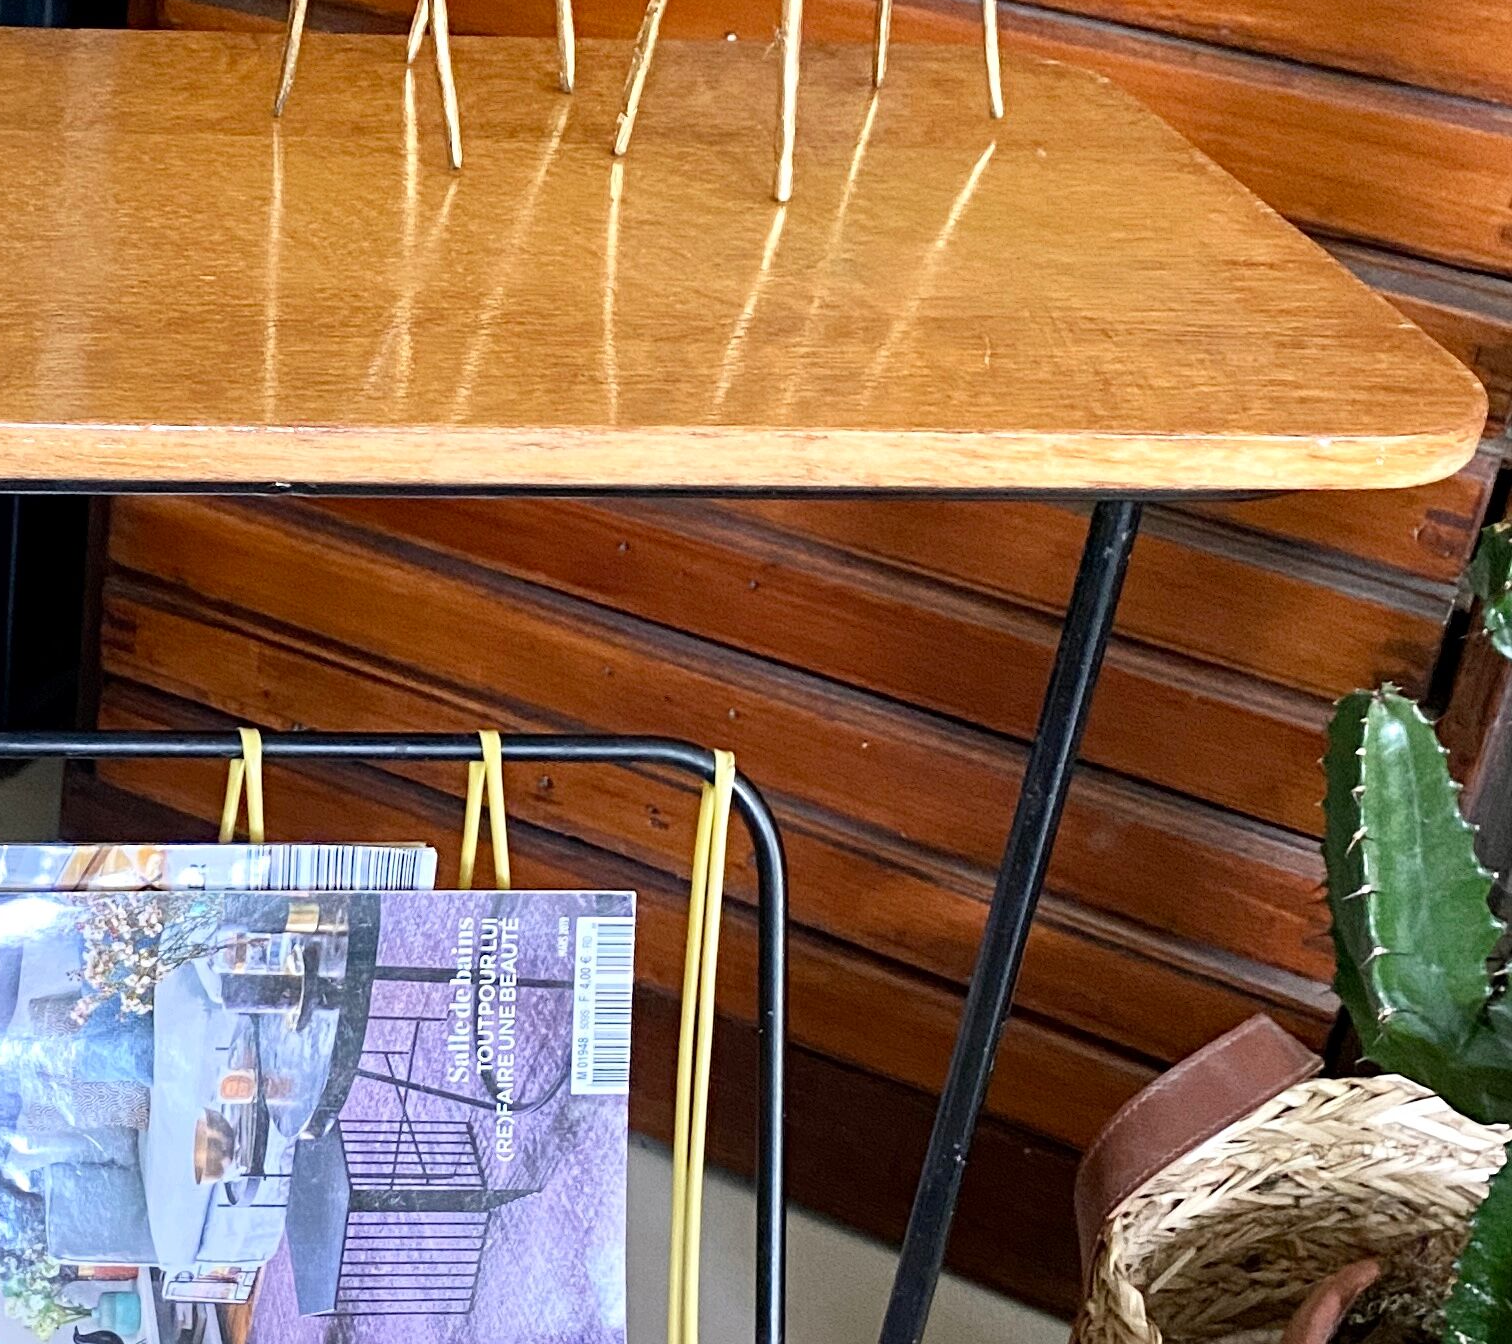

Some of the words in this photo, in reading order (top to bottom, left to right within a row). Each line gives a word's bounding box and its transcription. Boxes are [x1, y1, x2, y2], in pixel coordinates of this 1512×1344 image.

[449, 917, 475, 985] bains
[479, 917, 499, 952] LUI
[498, 917, 520, 1001] BEAUTÉ
[449, 989, 473, 1019] de
[477, 954, 498, 1016] POUR
[446, 1021, 473, 1084] Salle
[476, 1016, 497, 1073] TOUT
[497, 1005, 517, 1050] UNE
[495, 1053, 516, 1162] (RE)FAIRE
